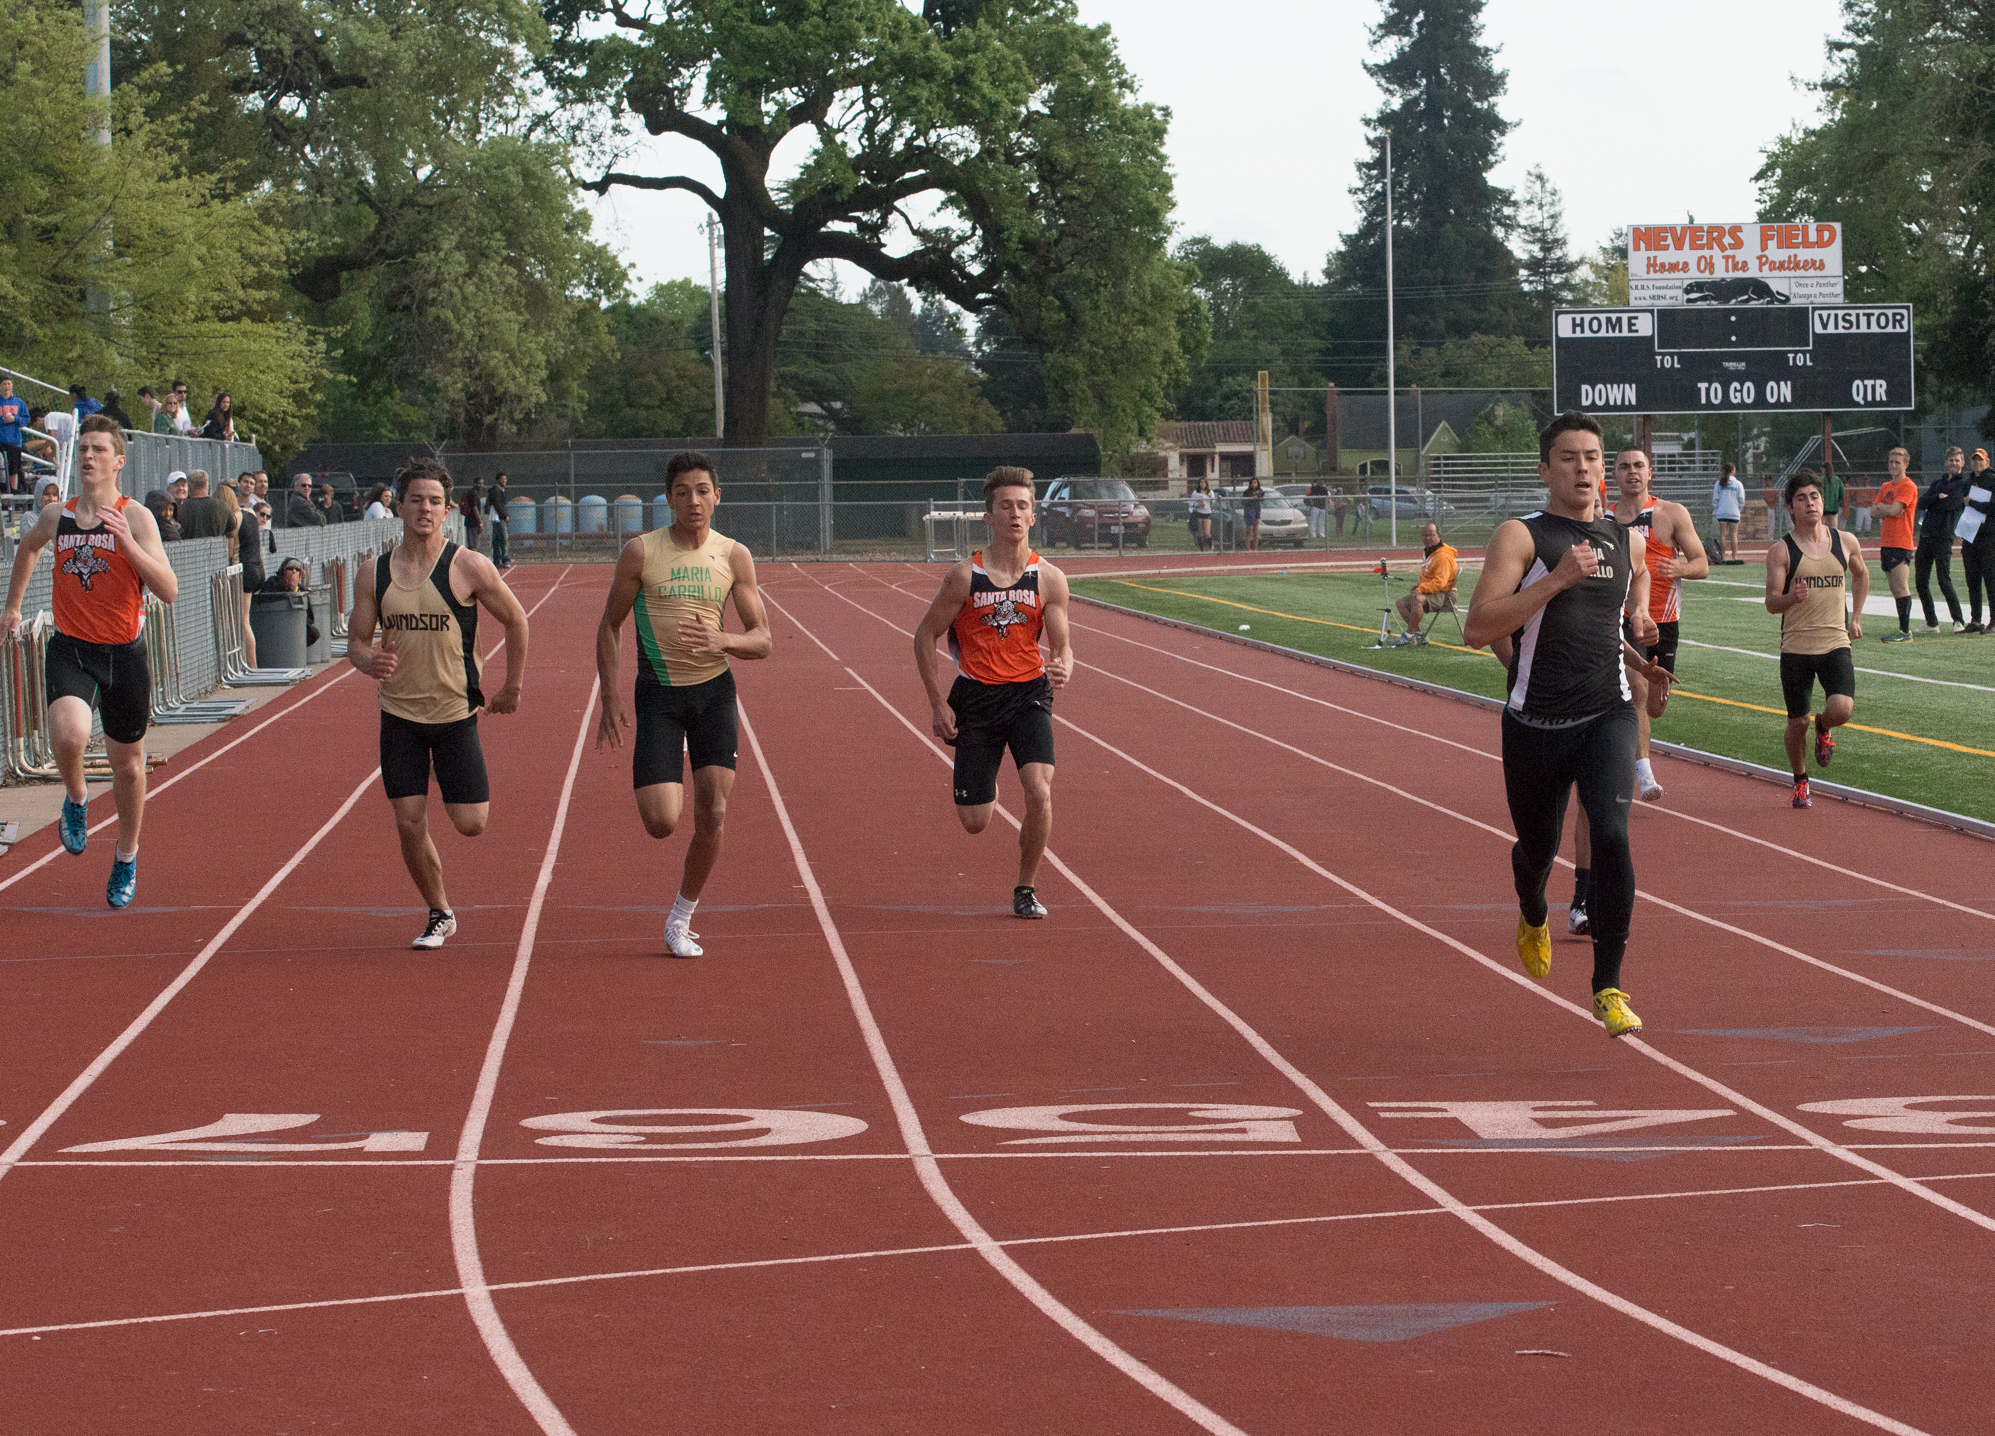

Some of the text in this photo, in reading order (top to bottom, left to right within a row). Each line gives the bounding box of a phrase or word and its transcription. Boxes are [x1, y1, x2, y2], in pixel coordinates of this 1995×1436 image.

[1633, 224, 1837, 253] NEVERS FIELD
[1646, 253, 1826, 276] Home Of The Panthers
[1571, 316, 1639, 334] HOME
[1818, 312, 1905, 331] VISITOR
[1655, 355, 1681, 369] TOL
[1787, 353, 1813, 366] TOL
[1581, 383, 1636, 406] DOWN
[1697, 380, 1792, 405] TO GO ON
[1852, 379, 1887, 405] QTR
[1629, 525, 1650, 538] SA
[57, 533, 117, 552] SANTA ROSA
[670, 566, 712, 582] MARIA
[658, 584, 722, 603] CARRILLO
[973, 589, 1037, 609] SANTA ROSA
[383, 613, 450, 632] WINDSOR
[519, 1108, 870, 1150] 6
[960, 1103, 1304, 1145] 5
[1366, 1101, 1738, 1139] 4
[57, 1113, 430, 1153] 7
